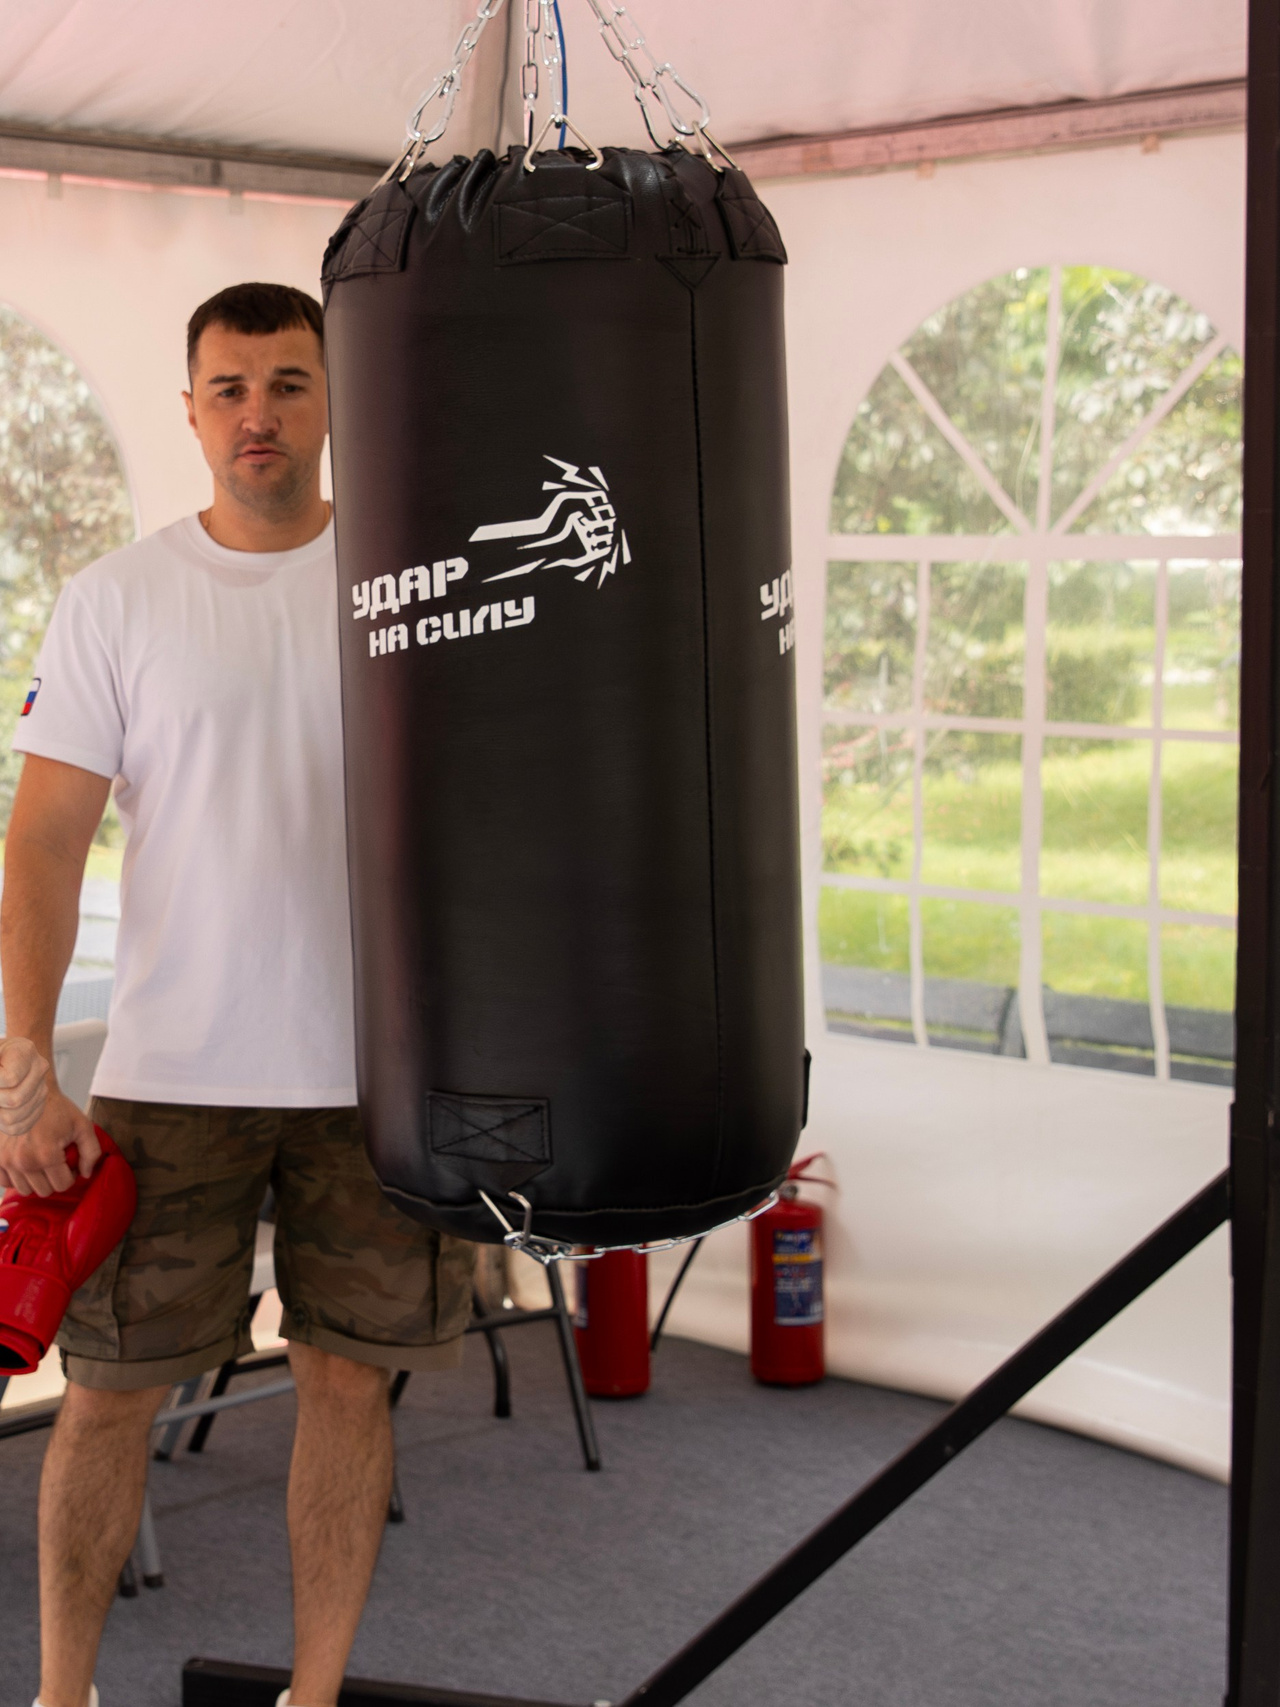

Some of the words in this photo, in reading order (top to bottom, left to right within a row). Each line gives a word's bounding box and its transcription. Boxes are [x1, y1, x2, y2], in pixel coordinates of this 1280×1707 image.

[351, 556, 469, 621] УДАР
[760, 569, 793, 621] УД
[369, 622, 409, 658] НА
[416, 595, 535, 646] СИЛУ
